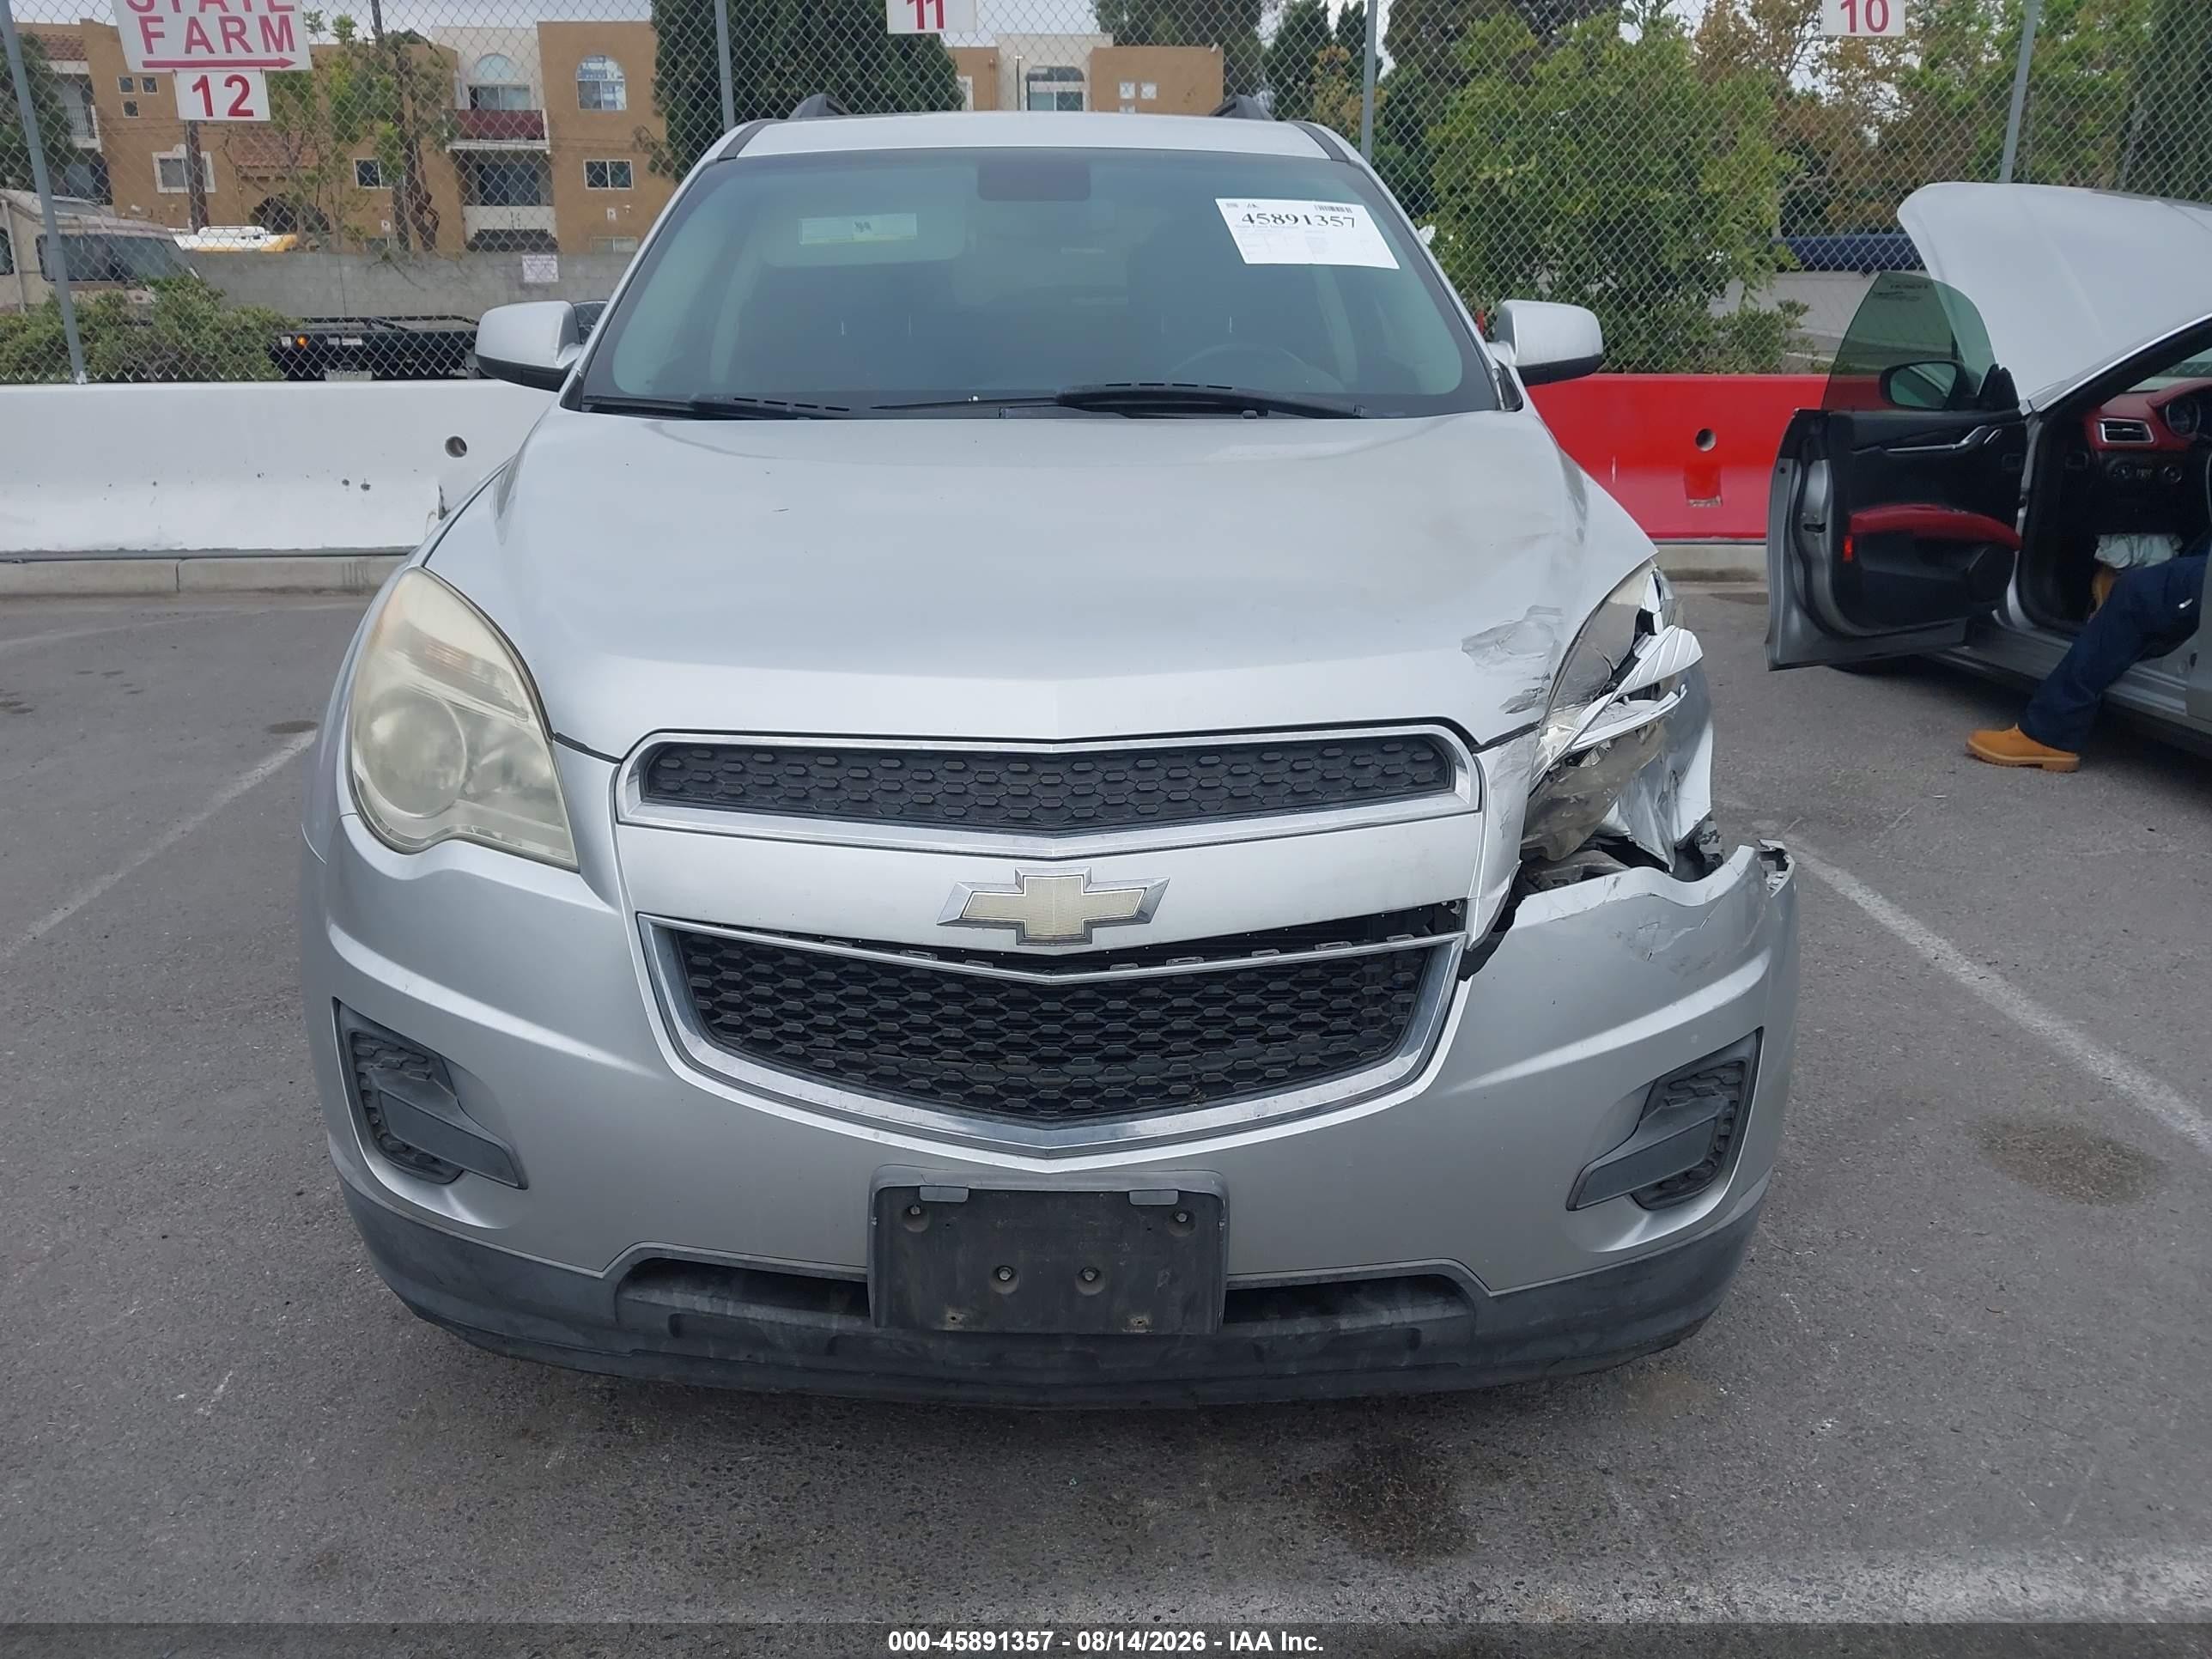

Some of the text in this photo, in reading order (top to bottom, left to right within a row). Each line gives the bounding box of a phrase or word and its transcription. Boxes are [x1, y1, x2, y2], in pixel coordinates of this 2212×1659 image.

[907, 0, 945, 29] 11
[1840, 0, 1889, 33] 10
[138, 15, 295, 54] FARM
[191, 74, 254, 117] 12
[1242, 213, 1355, 228] 45891357
